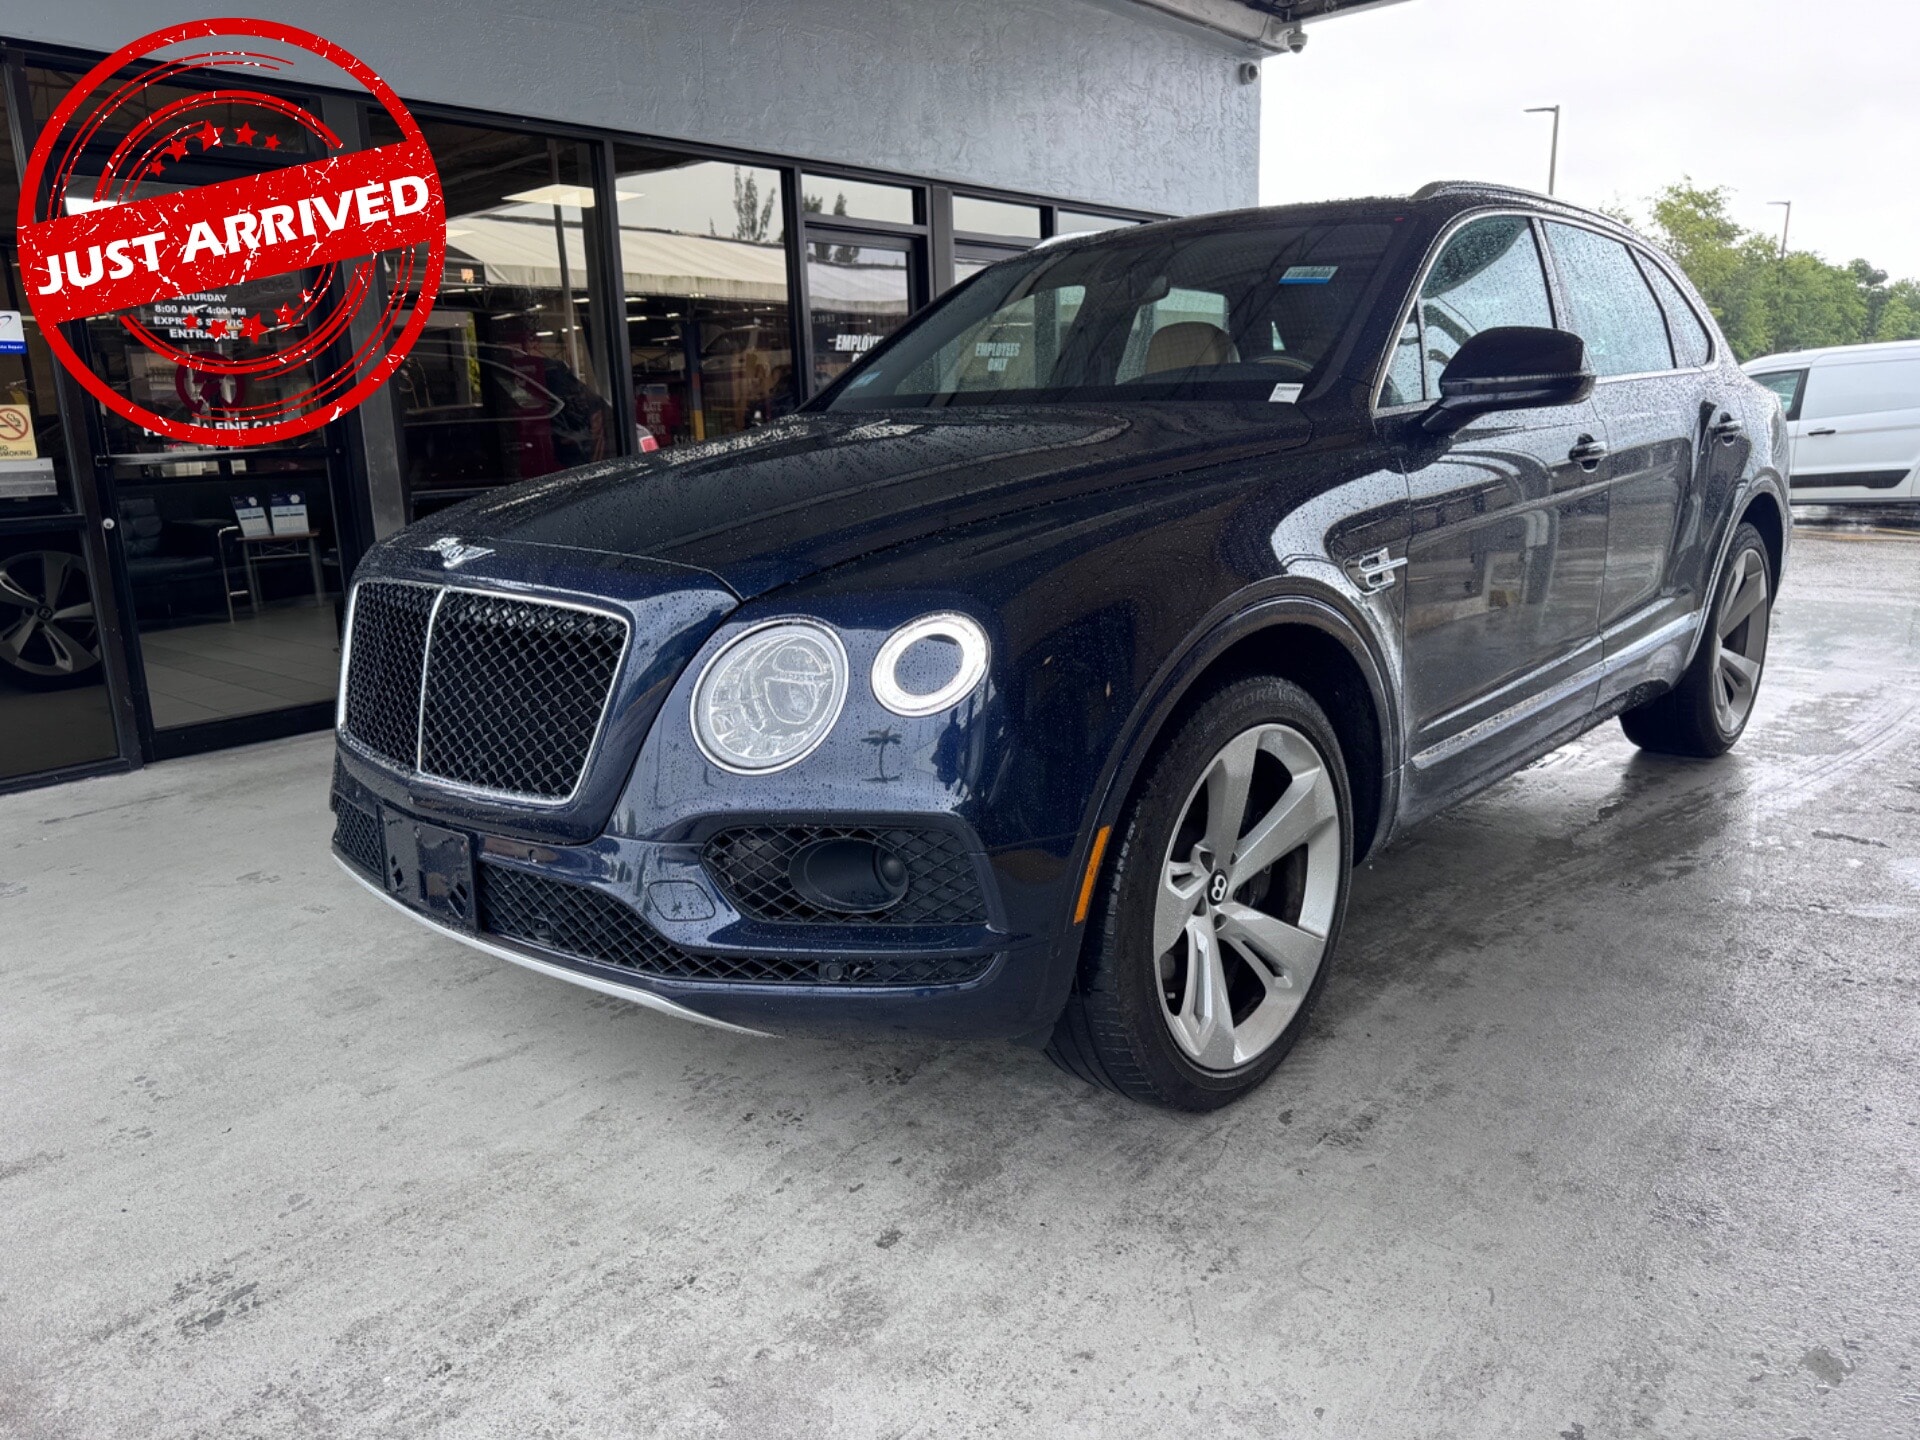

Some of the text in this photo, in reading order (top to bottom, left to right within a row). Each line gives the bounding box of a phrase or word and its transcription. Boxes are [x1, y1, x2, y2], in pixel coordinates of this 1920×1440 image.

[171, 293, 228, 302] ATURDAY
[154, 304, 178, 313] 8:00
[206, 306, 229, 314] 4:00
[230, 307, 247, 316] PM
[975, 342, 1020, 357] EMPLOYEES
[987, 358, 1008, 371] ONLY
